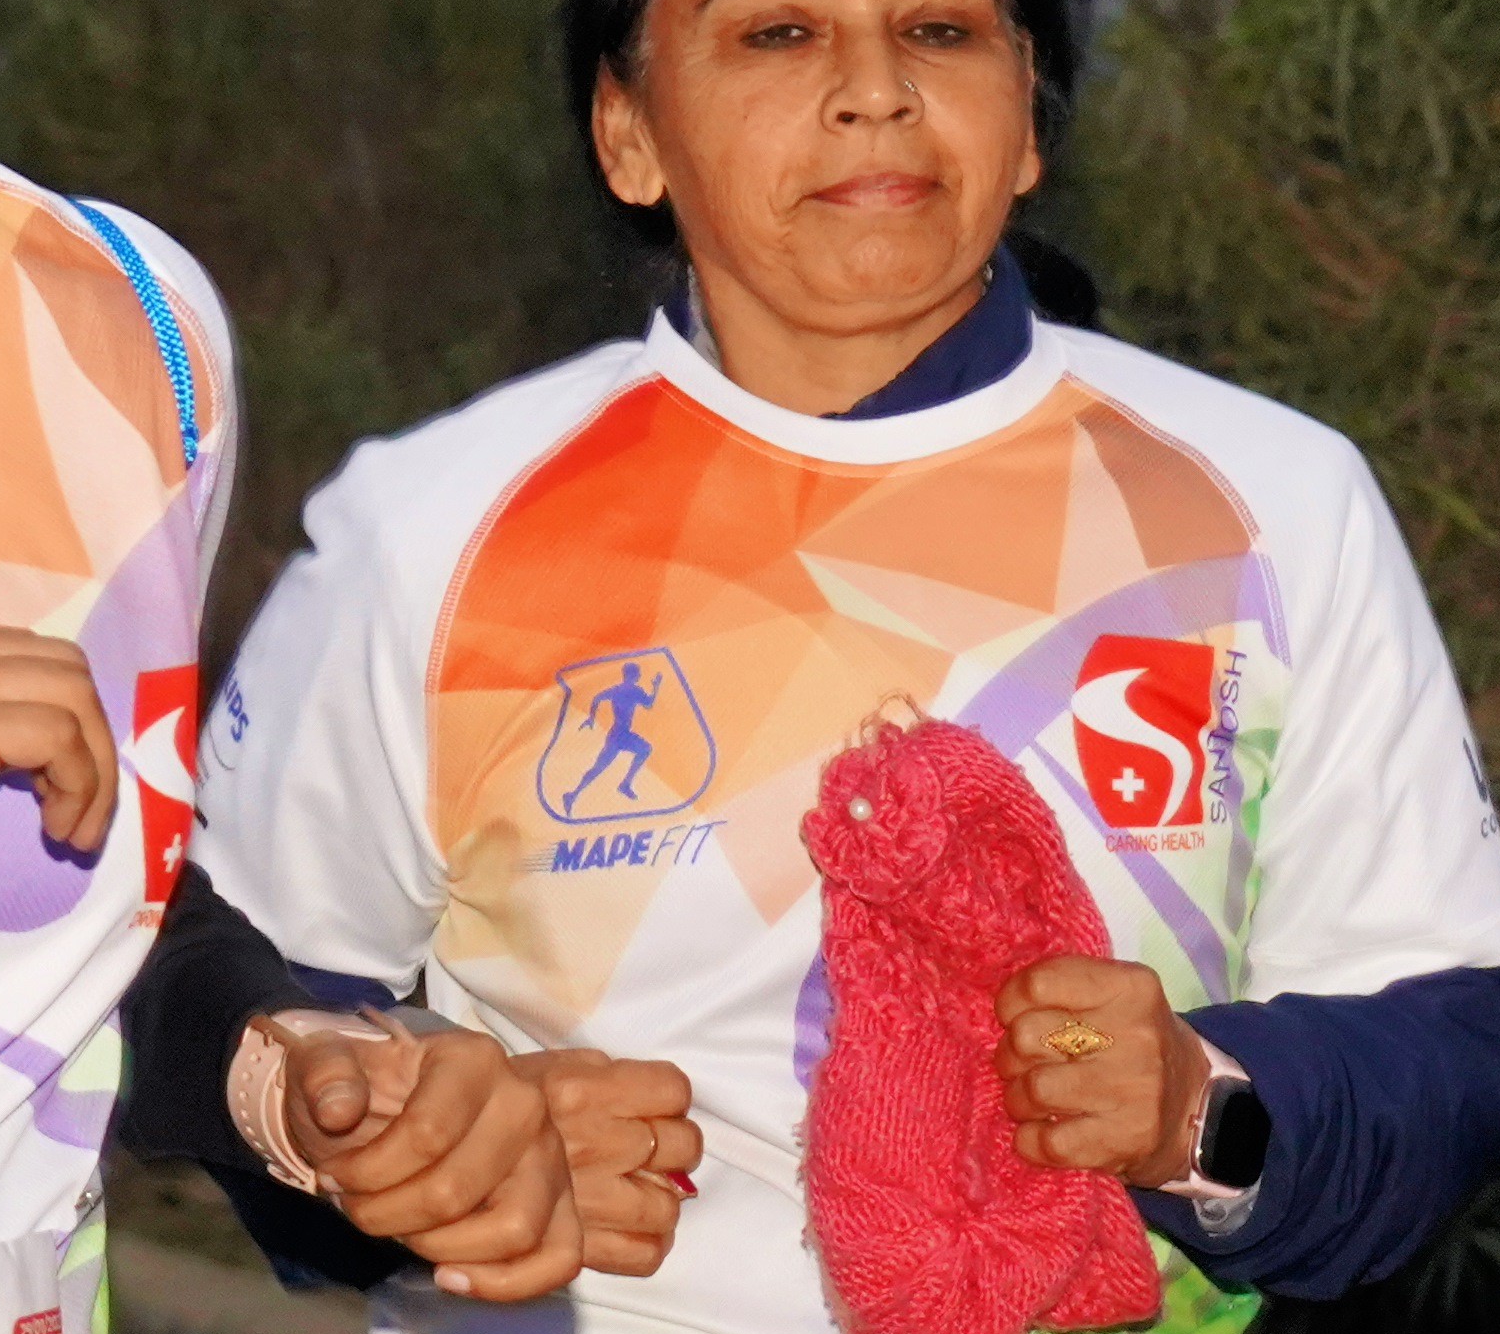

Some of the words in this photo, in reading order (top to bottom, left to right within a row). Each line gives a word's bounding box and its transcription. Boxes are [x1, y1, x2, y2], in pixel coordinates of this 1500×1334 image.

[1207, 650, 1247, 824] SANTOSH
[1105, 833, 1158, 853] CARING
[1161, 831, 1205, 851] HEALTH
